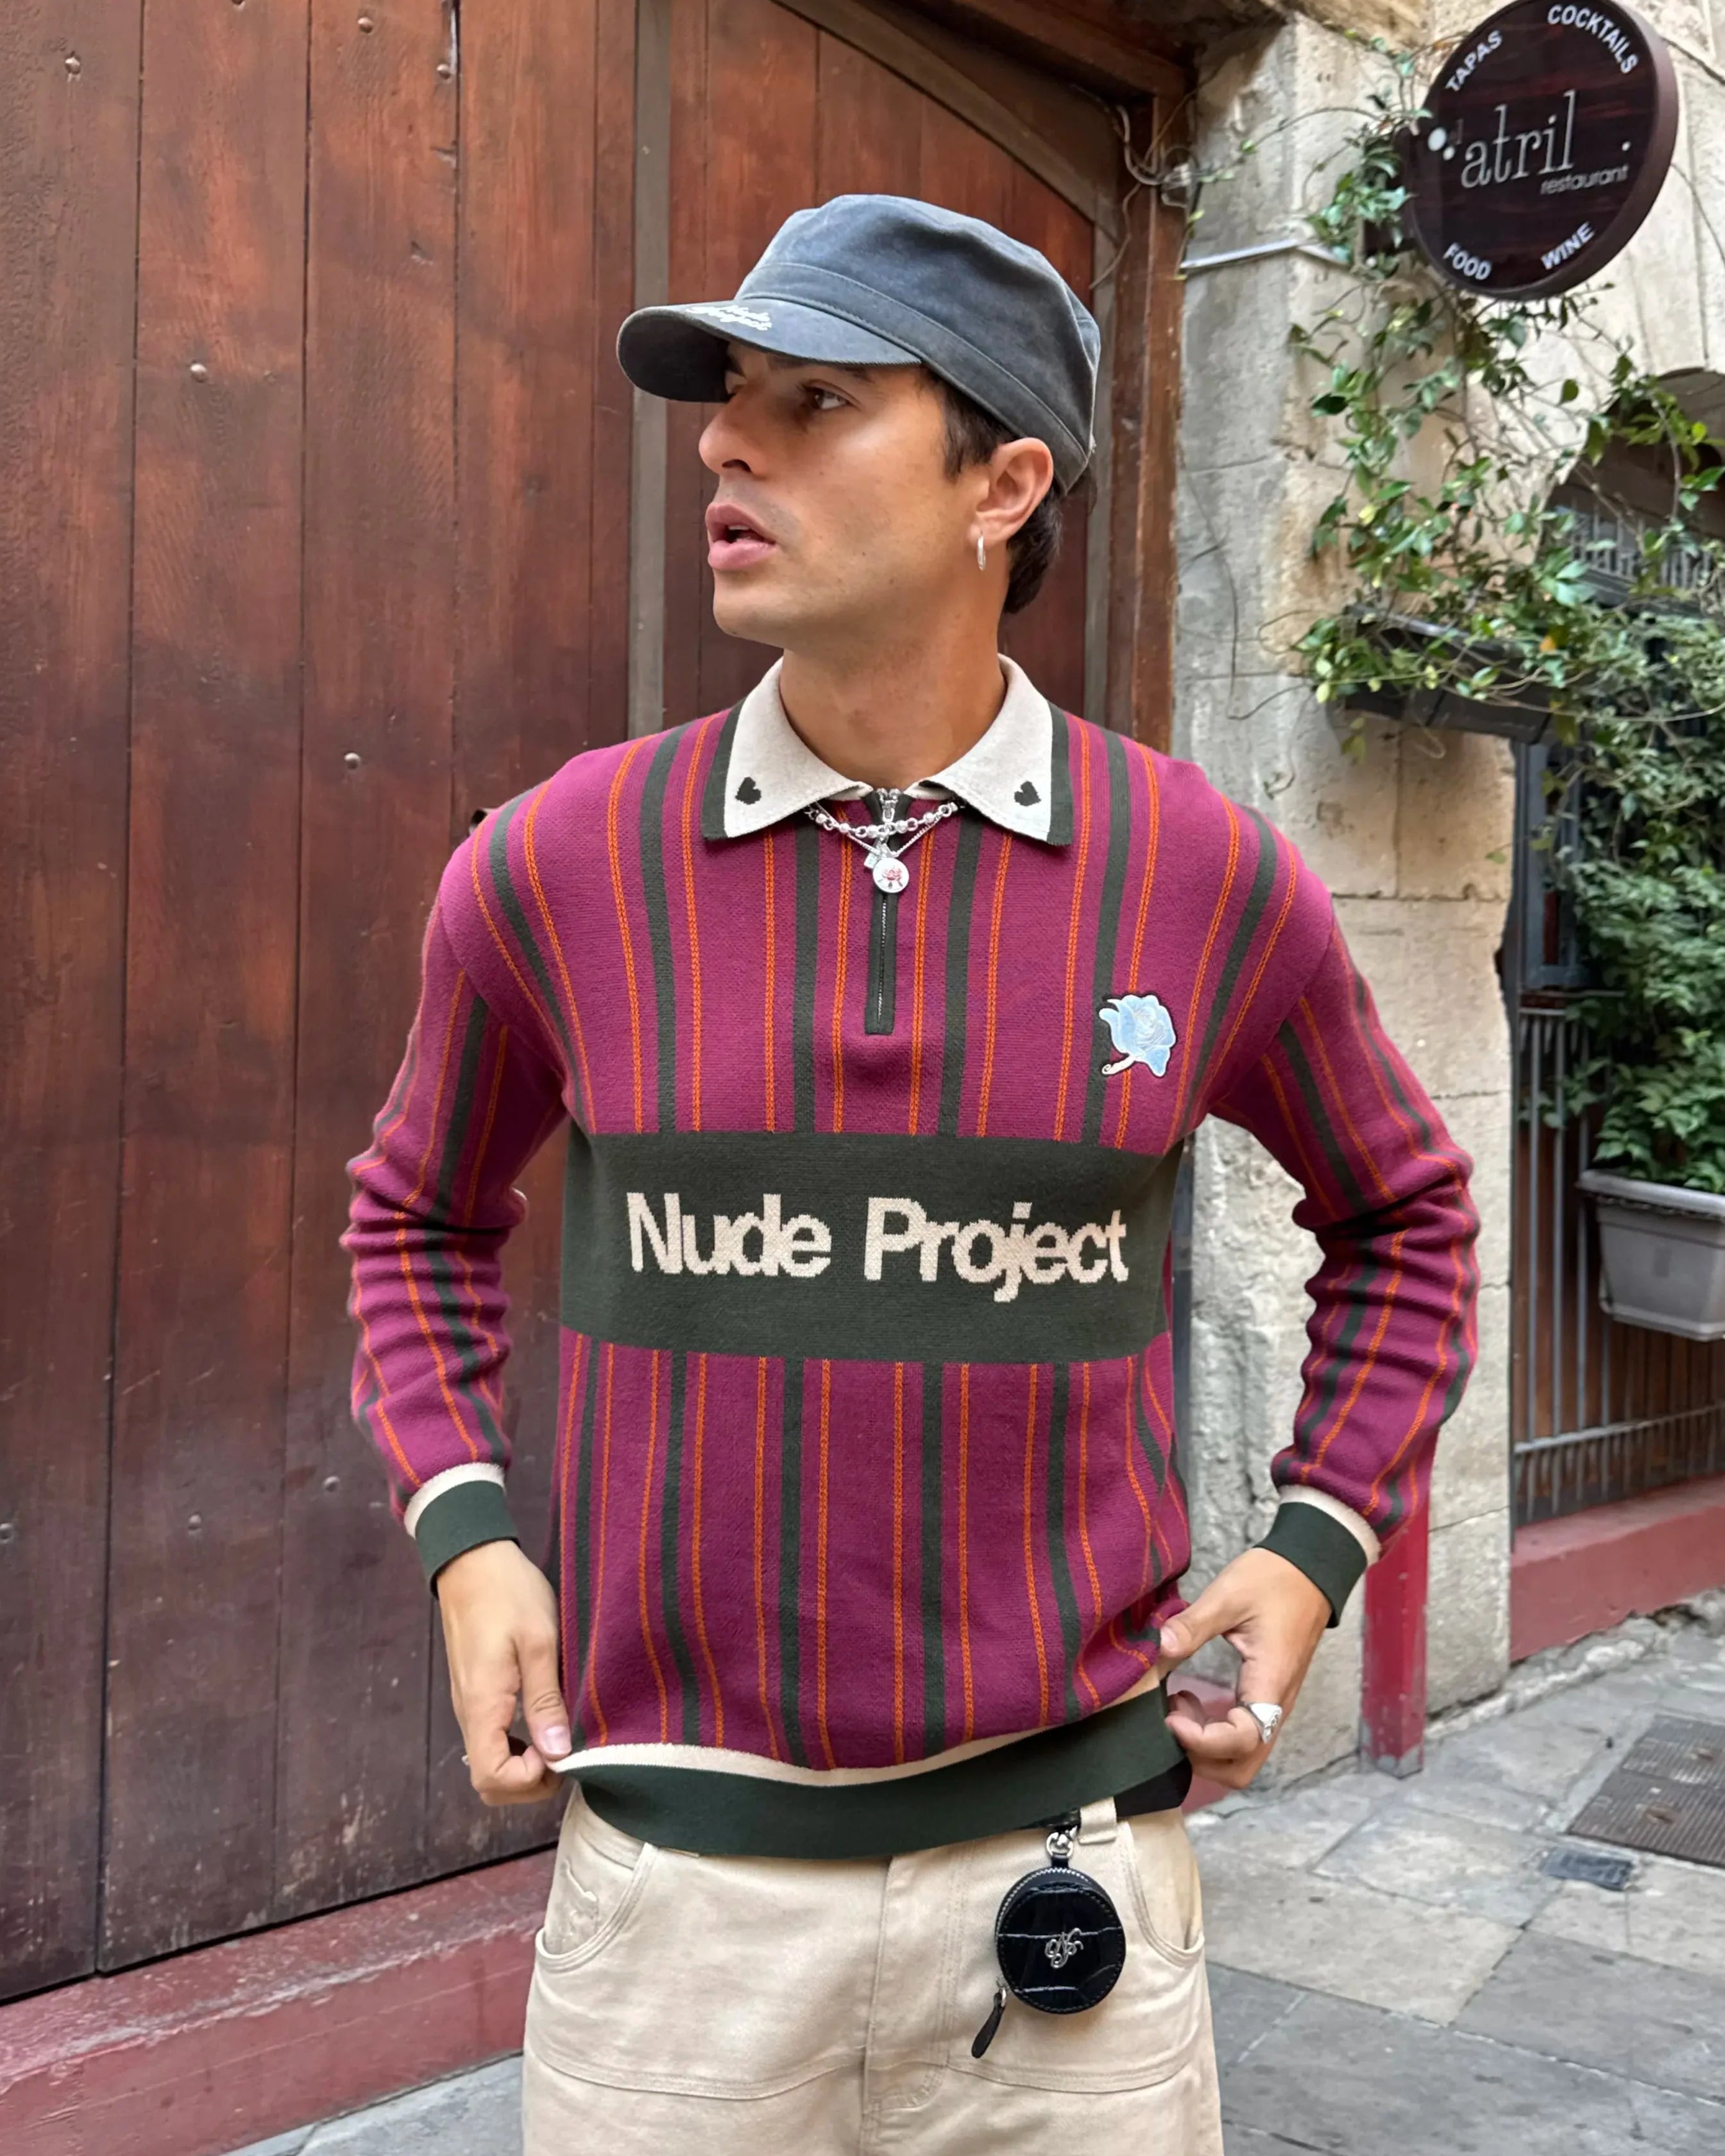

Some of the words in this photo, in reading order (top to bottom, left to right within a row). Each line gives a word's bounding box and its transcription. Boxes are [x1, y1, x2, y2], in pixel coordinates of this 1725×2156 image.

[1445, 31, 1502, 92] TAPAS
[1547, 5, 1638, 74] COCKTAILS
[1541, 165, 1629, 194] restaurant
[1443, 242, 1491, 280] FOOD
[1541, 222, 1595, 269] WINE
[627, 1192, 831, 1277] Nude
[864, 1197, 1129, 1302] Project
